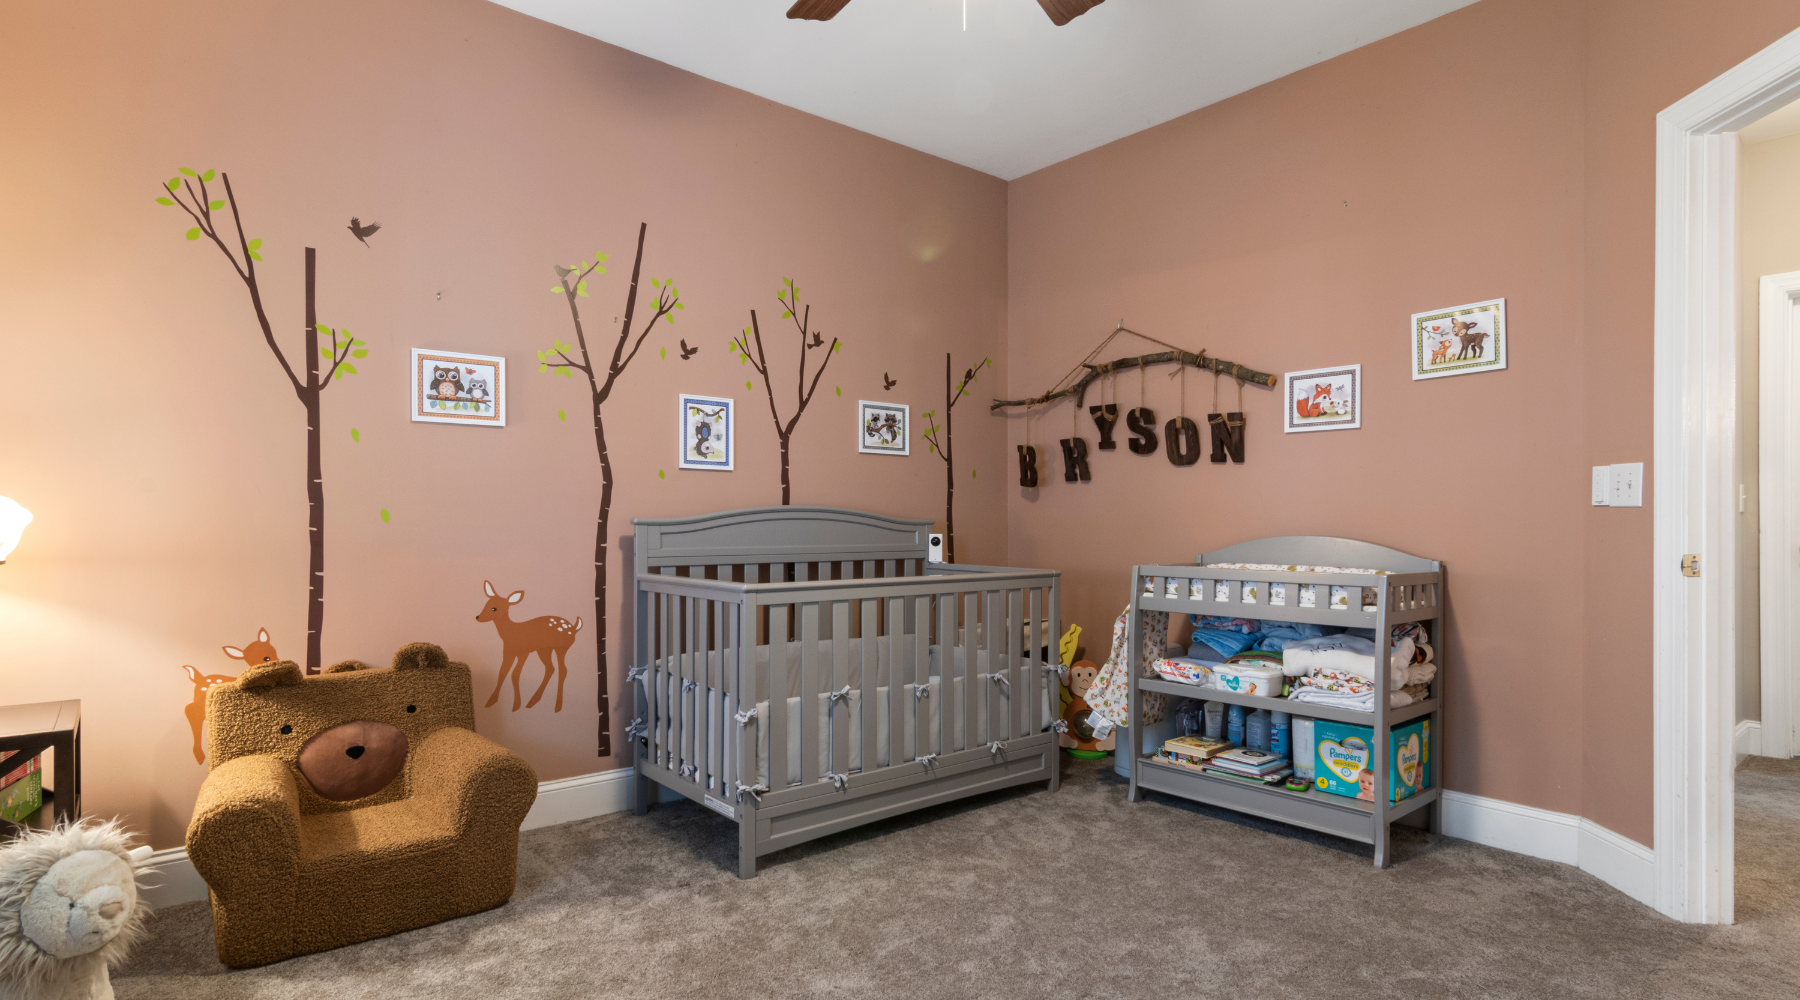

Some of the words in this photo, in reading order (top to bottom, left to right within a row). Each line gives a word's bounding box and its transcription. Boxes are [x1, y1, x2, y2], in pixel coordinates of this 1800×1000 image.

[1016, 403, 1246, 488] BRYSON
[1329, 747, 1362, 763] Pampers
[1402, 753, 1417, 765] Pampers
